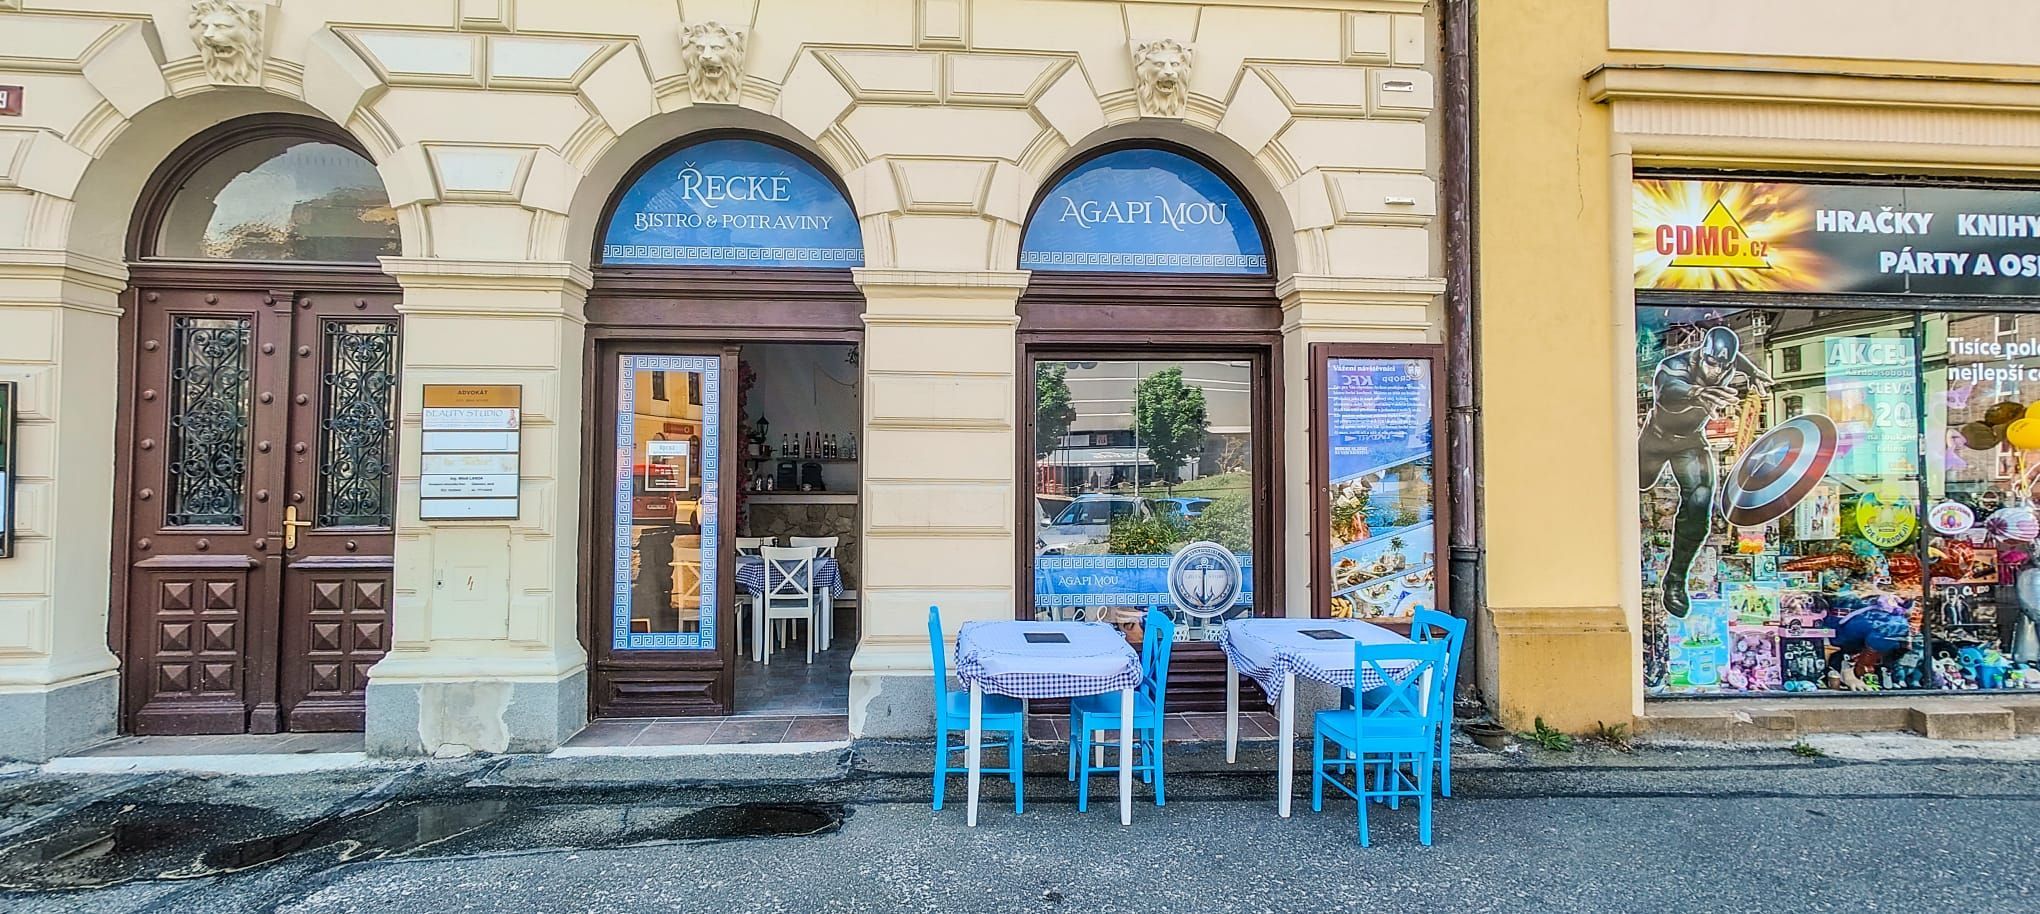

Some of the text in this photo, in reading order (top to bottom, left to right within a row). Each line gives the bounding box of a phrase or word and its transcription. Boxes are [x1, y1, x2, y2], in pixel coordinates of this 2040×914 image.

[678, 161, 791, 208] ŘECKÉ
[634, 213, 833, 232] BISTRO & POTRAVINY
[1059, 195, 1228, 232] AGAPI MOU
[1816, 206, 2040, 238] HRAČKY KNIHY
[1879, 246, 2040, 277] PÁRTY A OS
[1829, 343, 1907, 366] AKCE!
[1947, 337, 2040, 360] Tisíce pol
[1948, 362, 2040, 385] nejlepší c
[1868, 382, 1915, 395] SLEVA
[1058, 574, 1119, 588] AGAPI MOU
